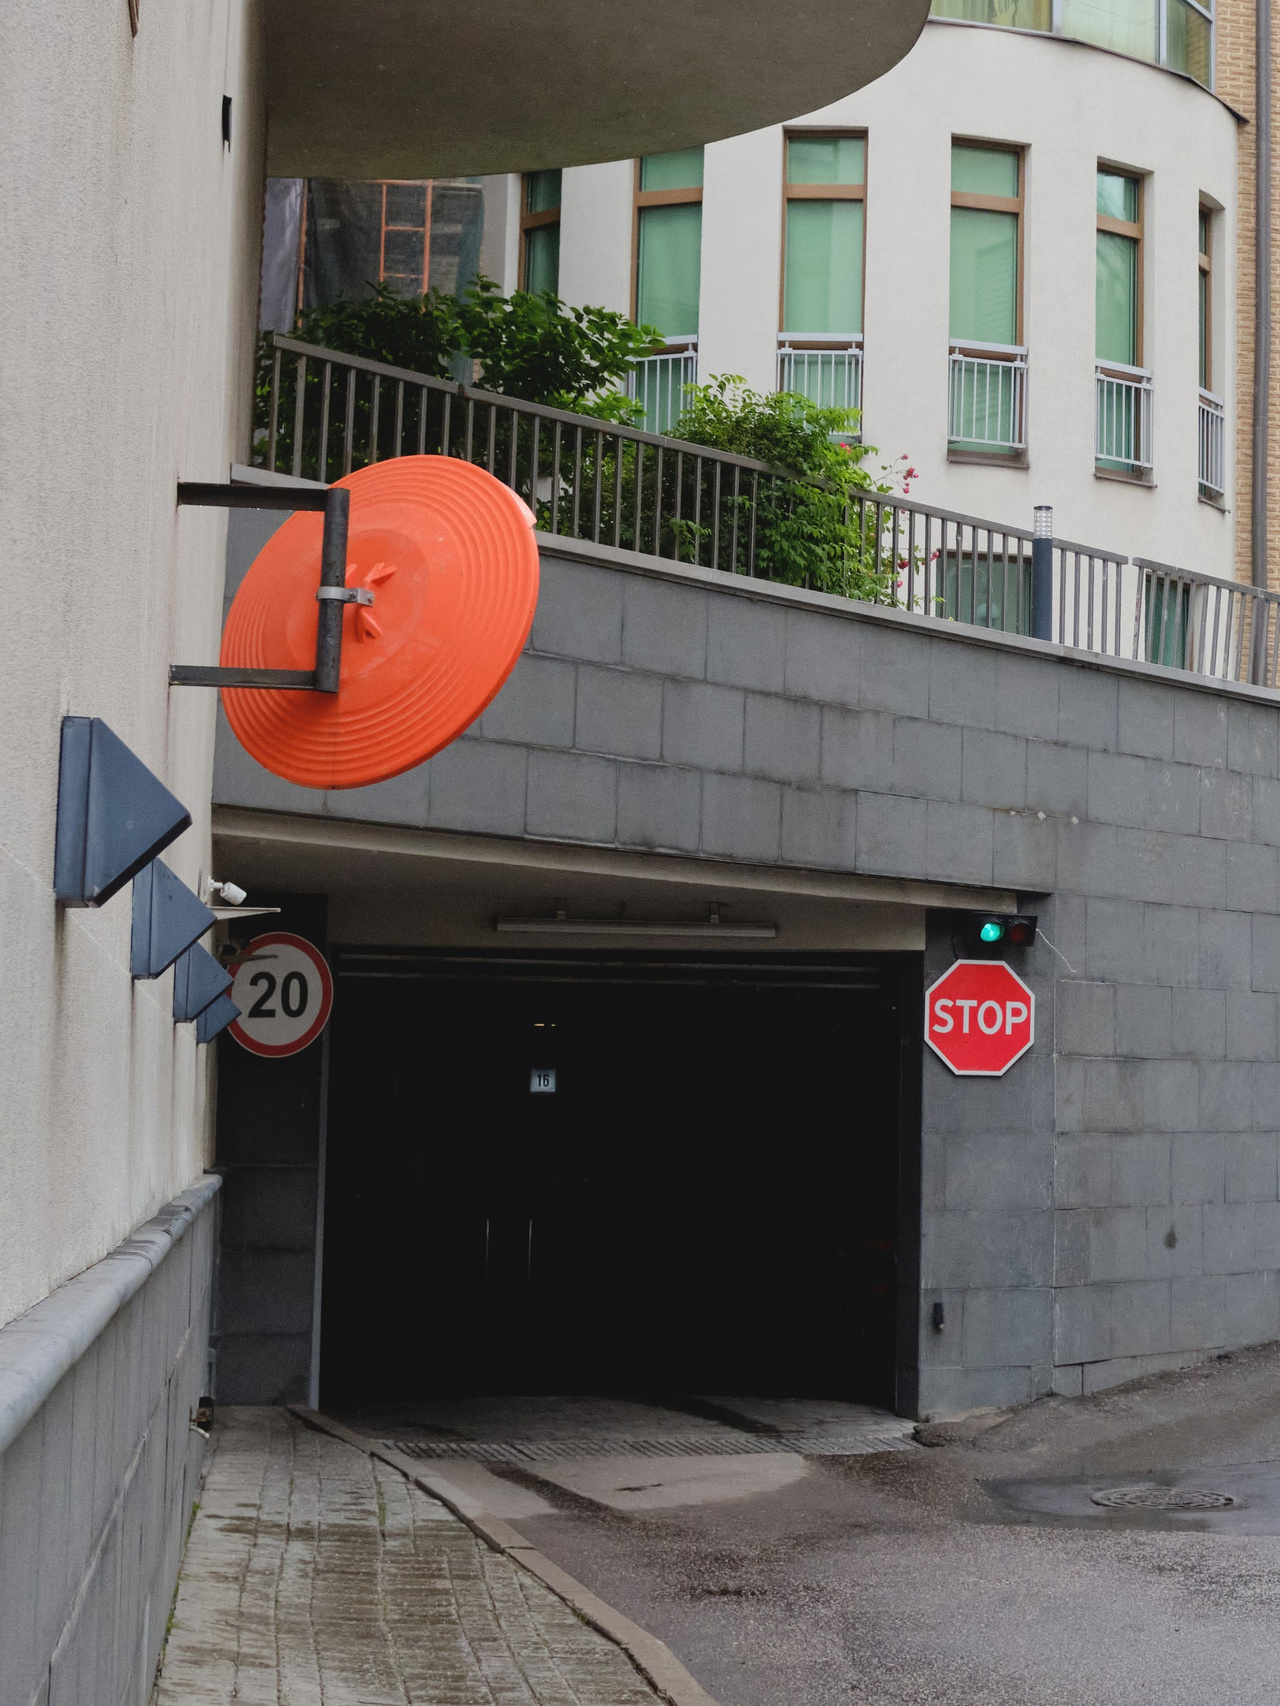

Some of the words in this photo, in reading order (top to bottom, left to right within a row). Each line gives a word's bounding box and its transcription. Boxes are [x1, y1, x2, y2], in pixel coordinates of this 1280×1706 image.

[248, 971, 308, 1018] 20
[932, 998, 1028, 1035] STOP
[537, 1073, 550, 1087] 16
